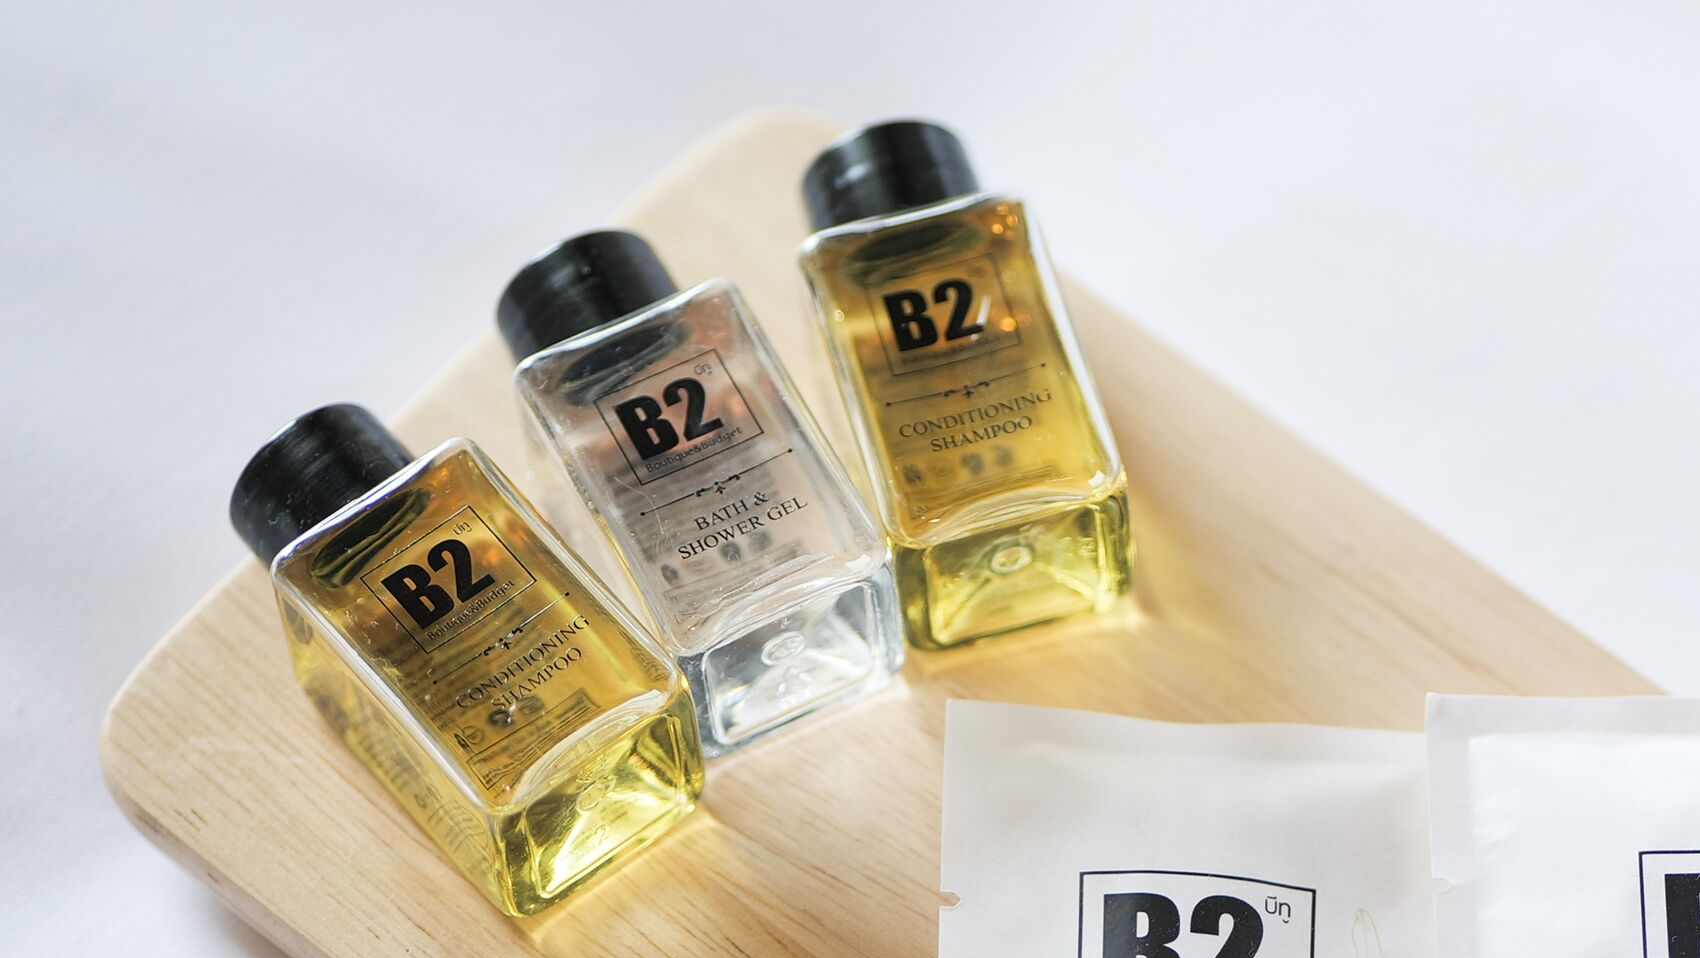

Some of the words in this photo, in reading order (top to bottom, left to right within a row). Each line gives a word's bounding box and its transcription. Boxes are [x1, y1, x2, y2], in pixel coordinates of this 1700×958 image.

[881, 277, 984, 352] B2
[613, 376, 724, 461] B2
[899, 388, 1052, 438] CONDITIONING
[930, 415, 1033, 452] SHAMPOO
[645, 426, 743, 473] Boutique&Budget
[677, 515, 765, 560] SHOWER
[766, 496, 808, 523] GEL
[693, 499, 748, 531] BATH
[753, 490, 769, 507] &
[381, 539, 496, 630] B2
[425, 578, 516, 641] Boutique&Budget
[455, 614, 590, 709] CONDITIONING
[491, 647, 583, 710] SHAMPOO
